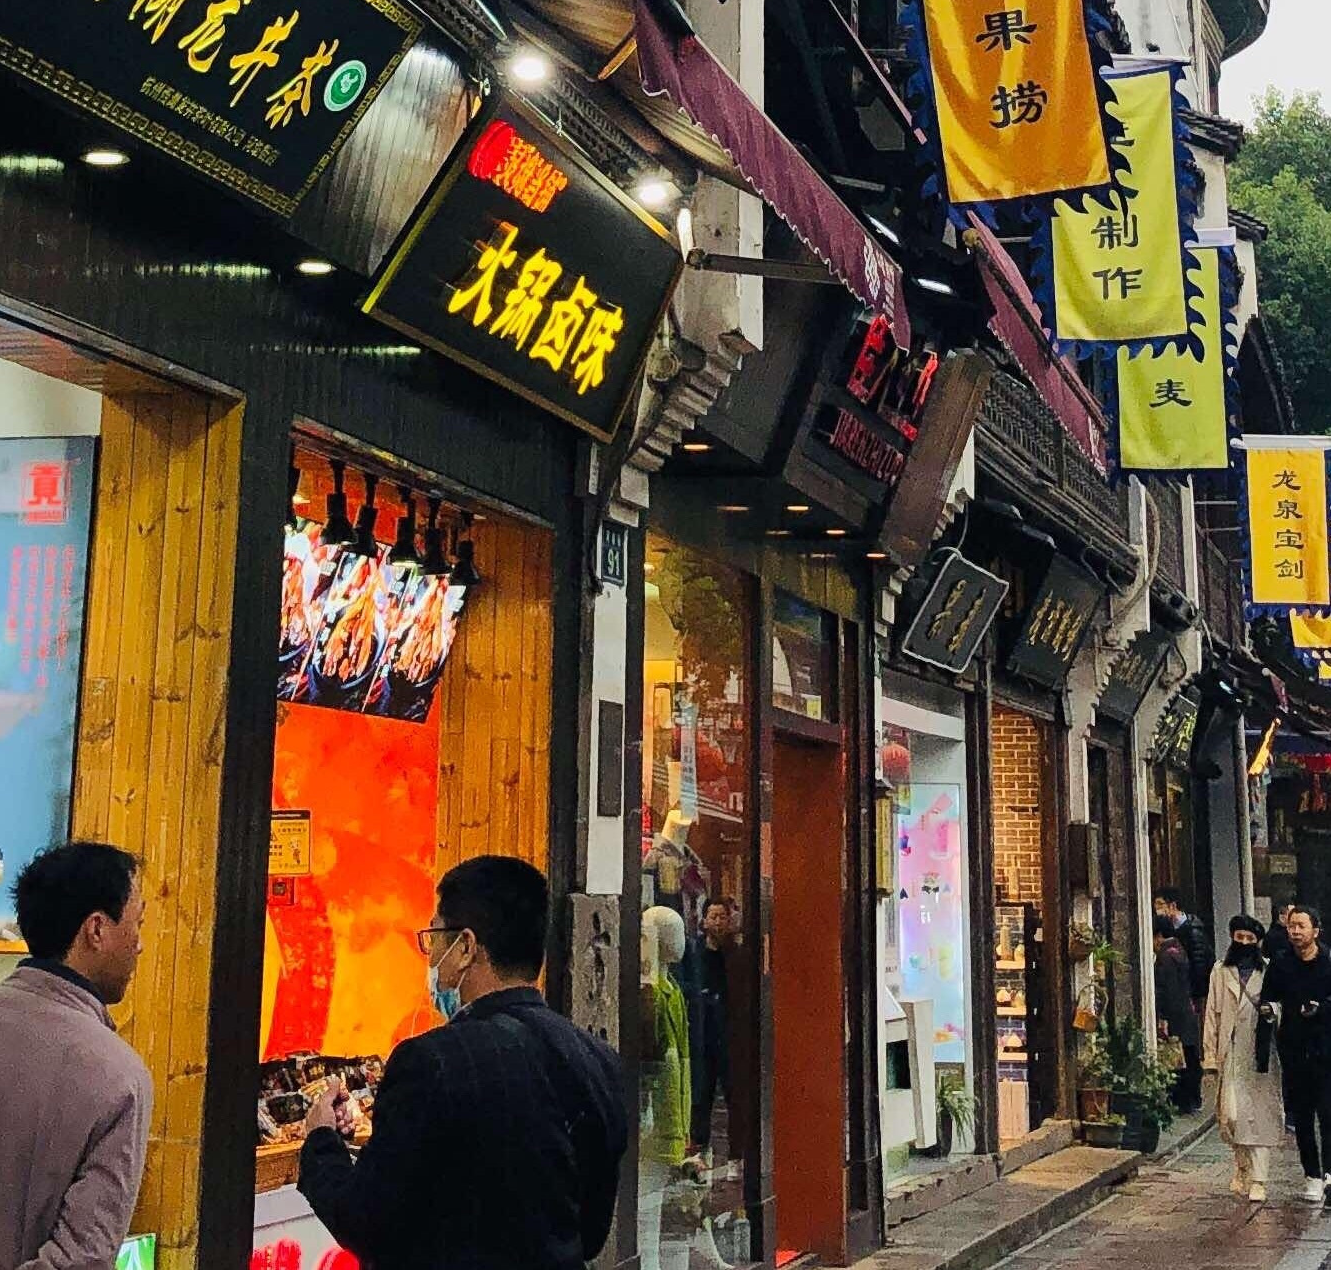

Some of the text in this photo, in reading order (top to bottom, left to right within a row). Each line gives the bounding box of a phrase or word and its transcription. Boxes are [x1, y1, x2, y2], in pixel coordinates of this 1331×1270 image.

[447, 221, 625, 396] 火锅卤味
[1149, 379, 1193, 408] 麦
[1272, 470, 1304, 579] 龙泉宝剑
[607, 548, 620, 577] 91
